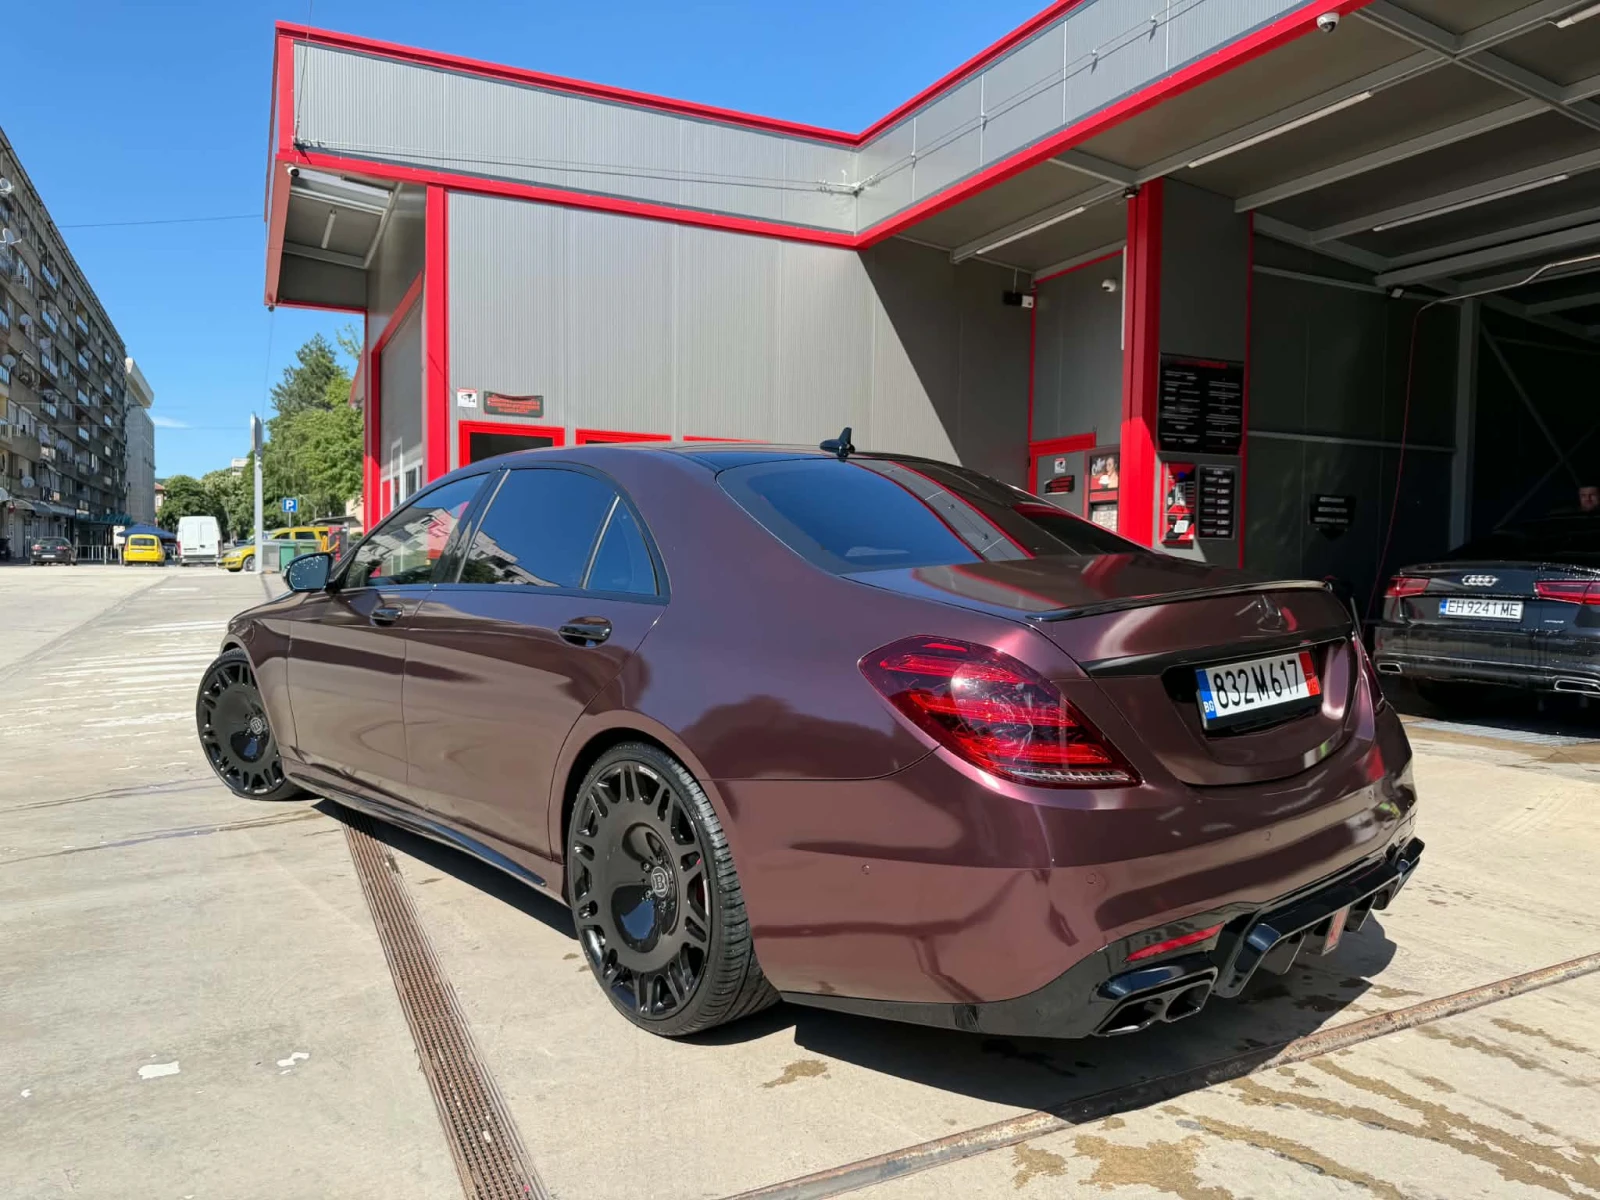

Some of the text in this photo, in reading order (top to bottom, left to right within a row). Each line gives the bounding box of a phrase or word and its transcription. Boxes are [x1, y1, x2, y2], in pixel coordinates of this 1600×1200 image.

[286, 500, 295, 510] P
[1448, 600, 1519, 617] EH 9241 ME
[1213, 659, 1299, 709] 832M617
[1203, 701, 1215, 713] BG
